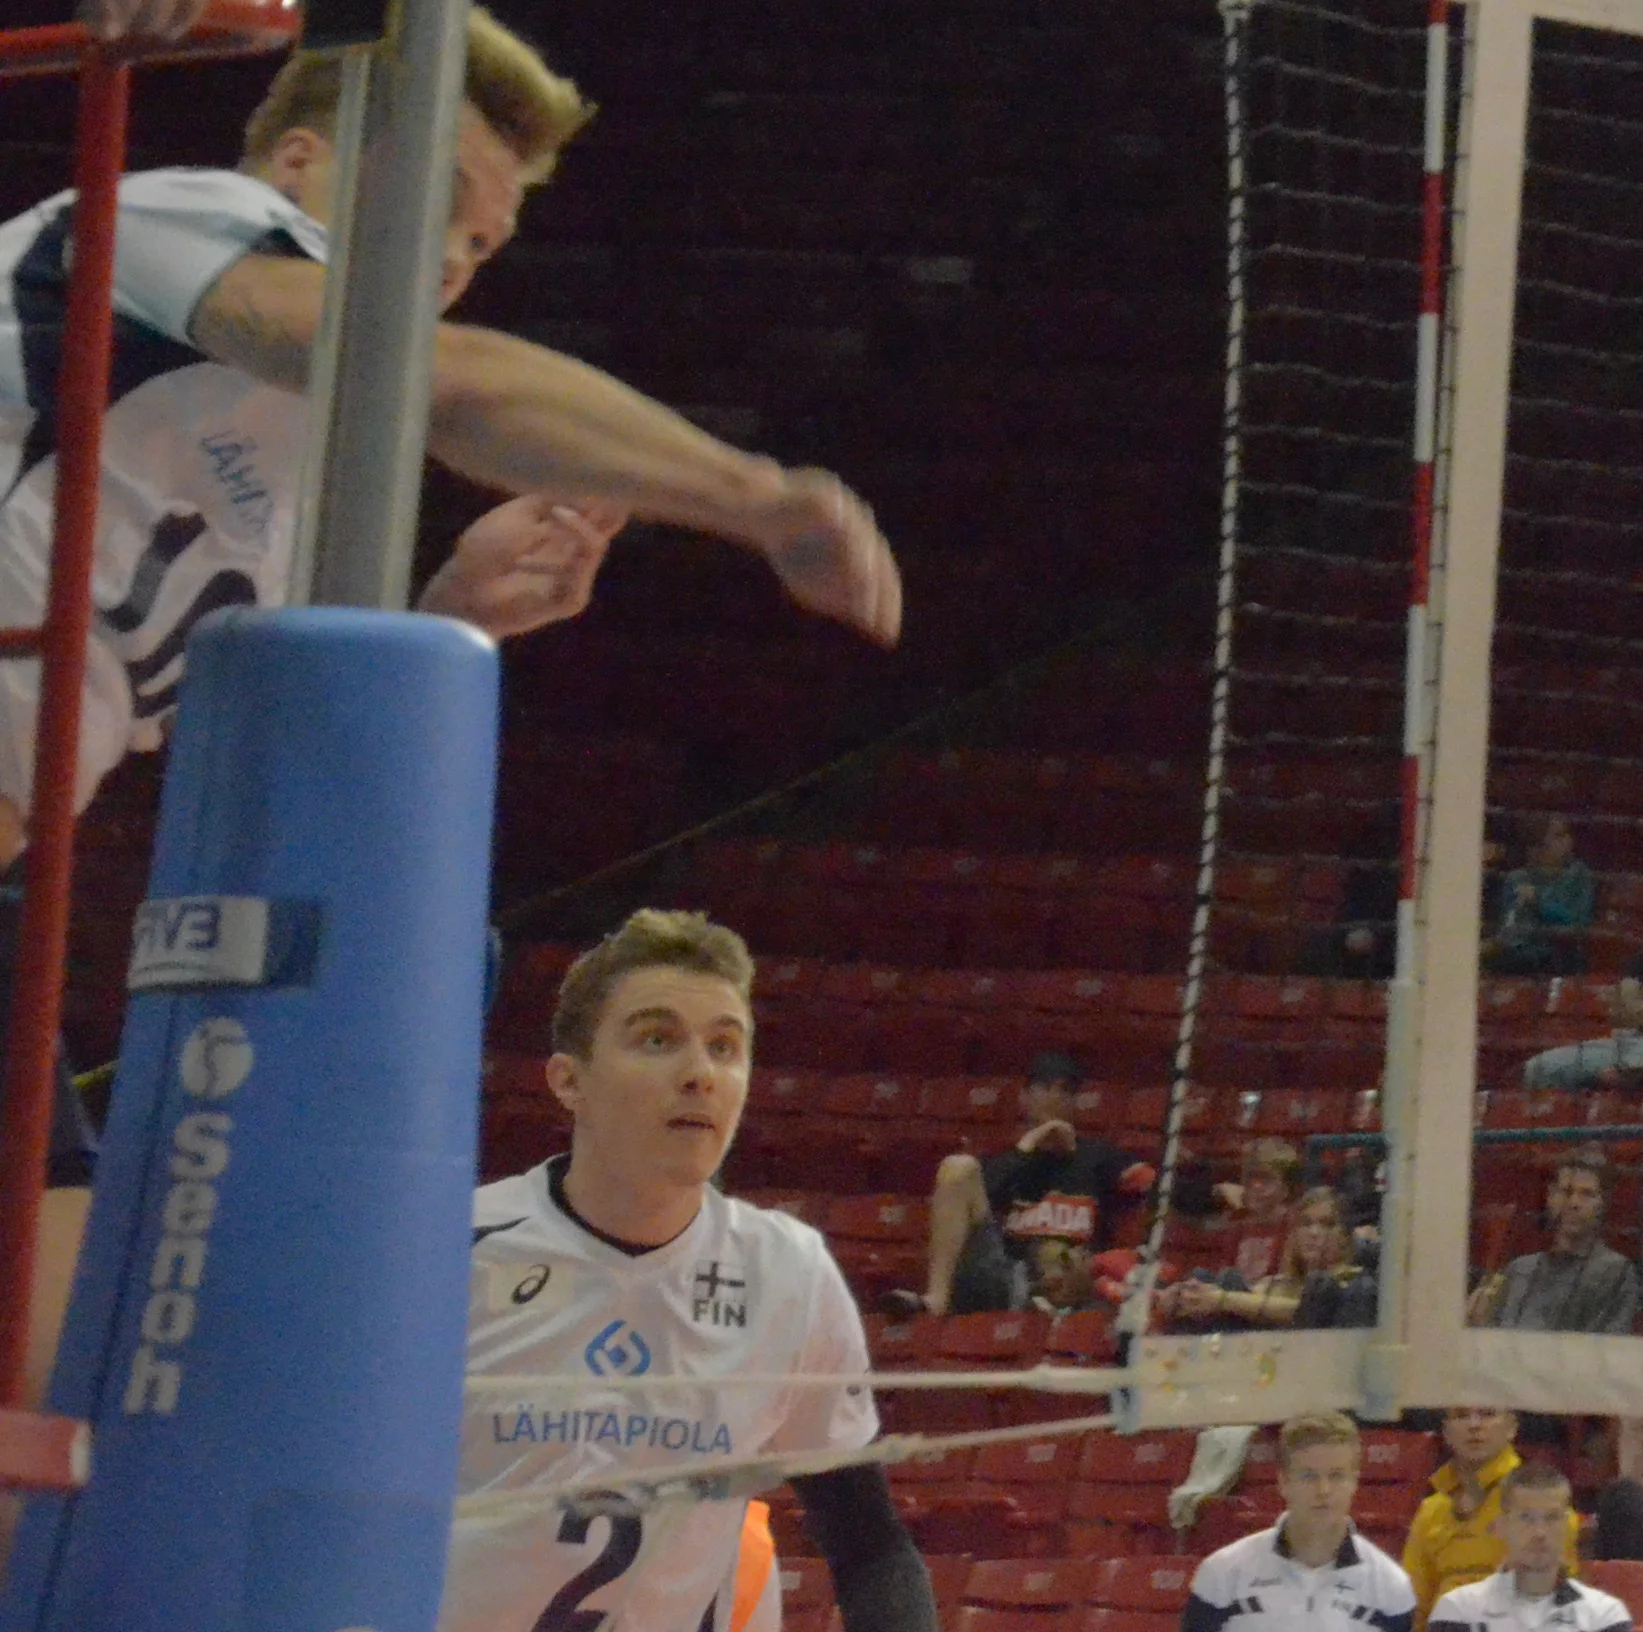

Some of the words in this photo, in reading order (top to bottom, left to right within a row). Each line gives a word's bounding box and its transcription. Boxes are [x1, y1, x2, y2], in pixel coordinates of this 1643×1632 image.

[123, 1112, 235, 1415] Senoh
[692, 1297, 748, 1329] FIN
[493, 1402, 734, 1456] LÄHITAPIOLA
[527, 1489, 643, 1632] 2
